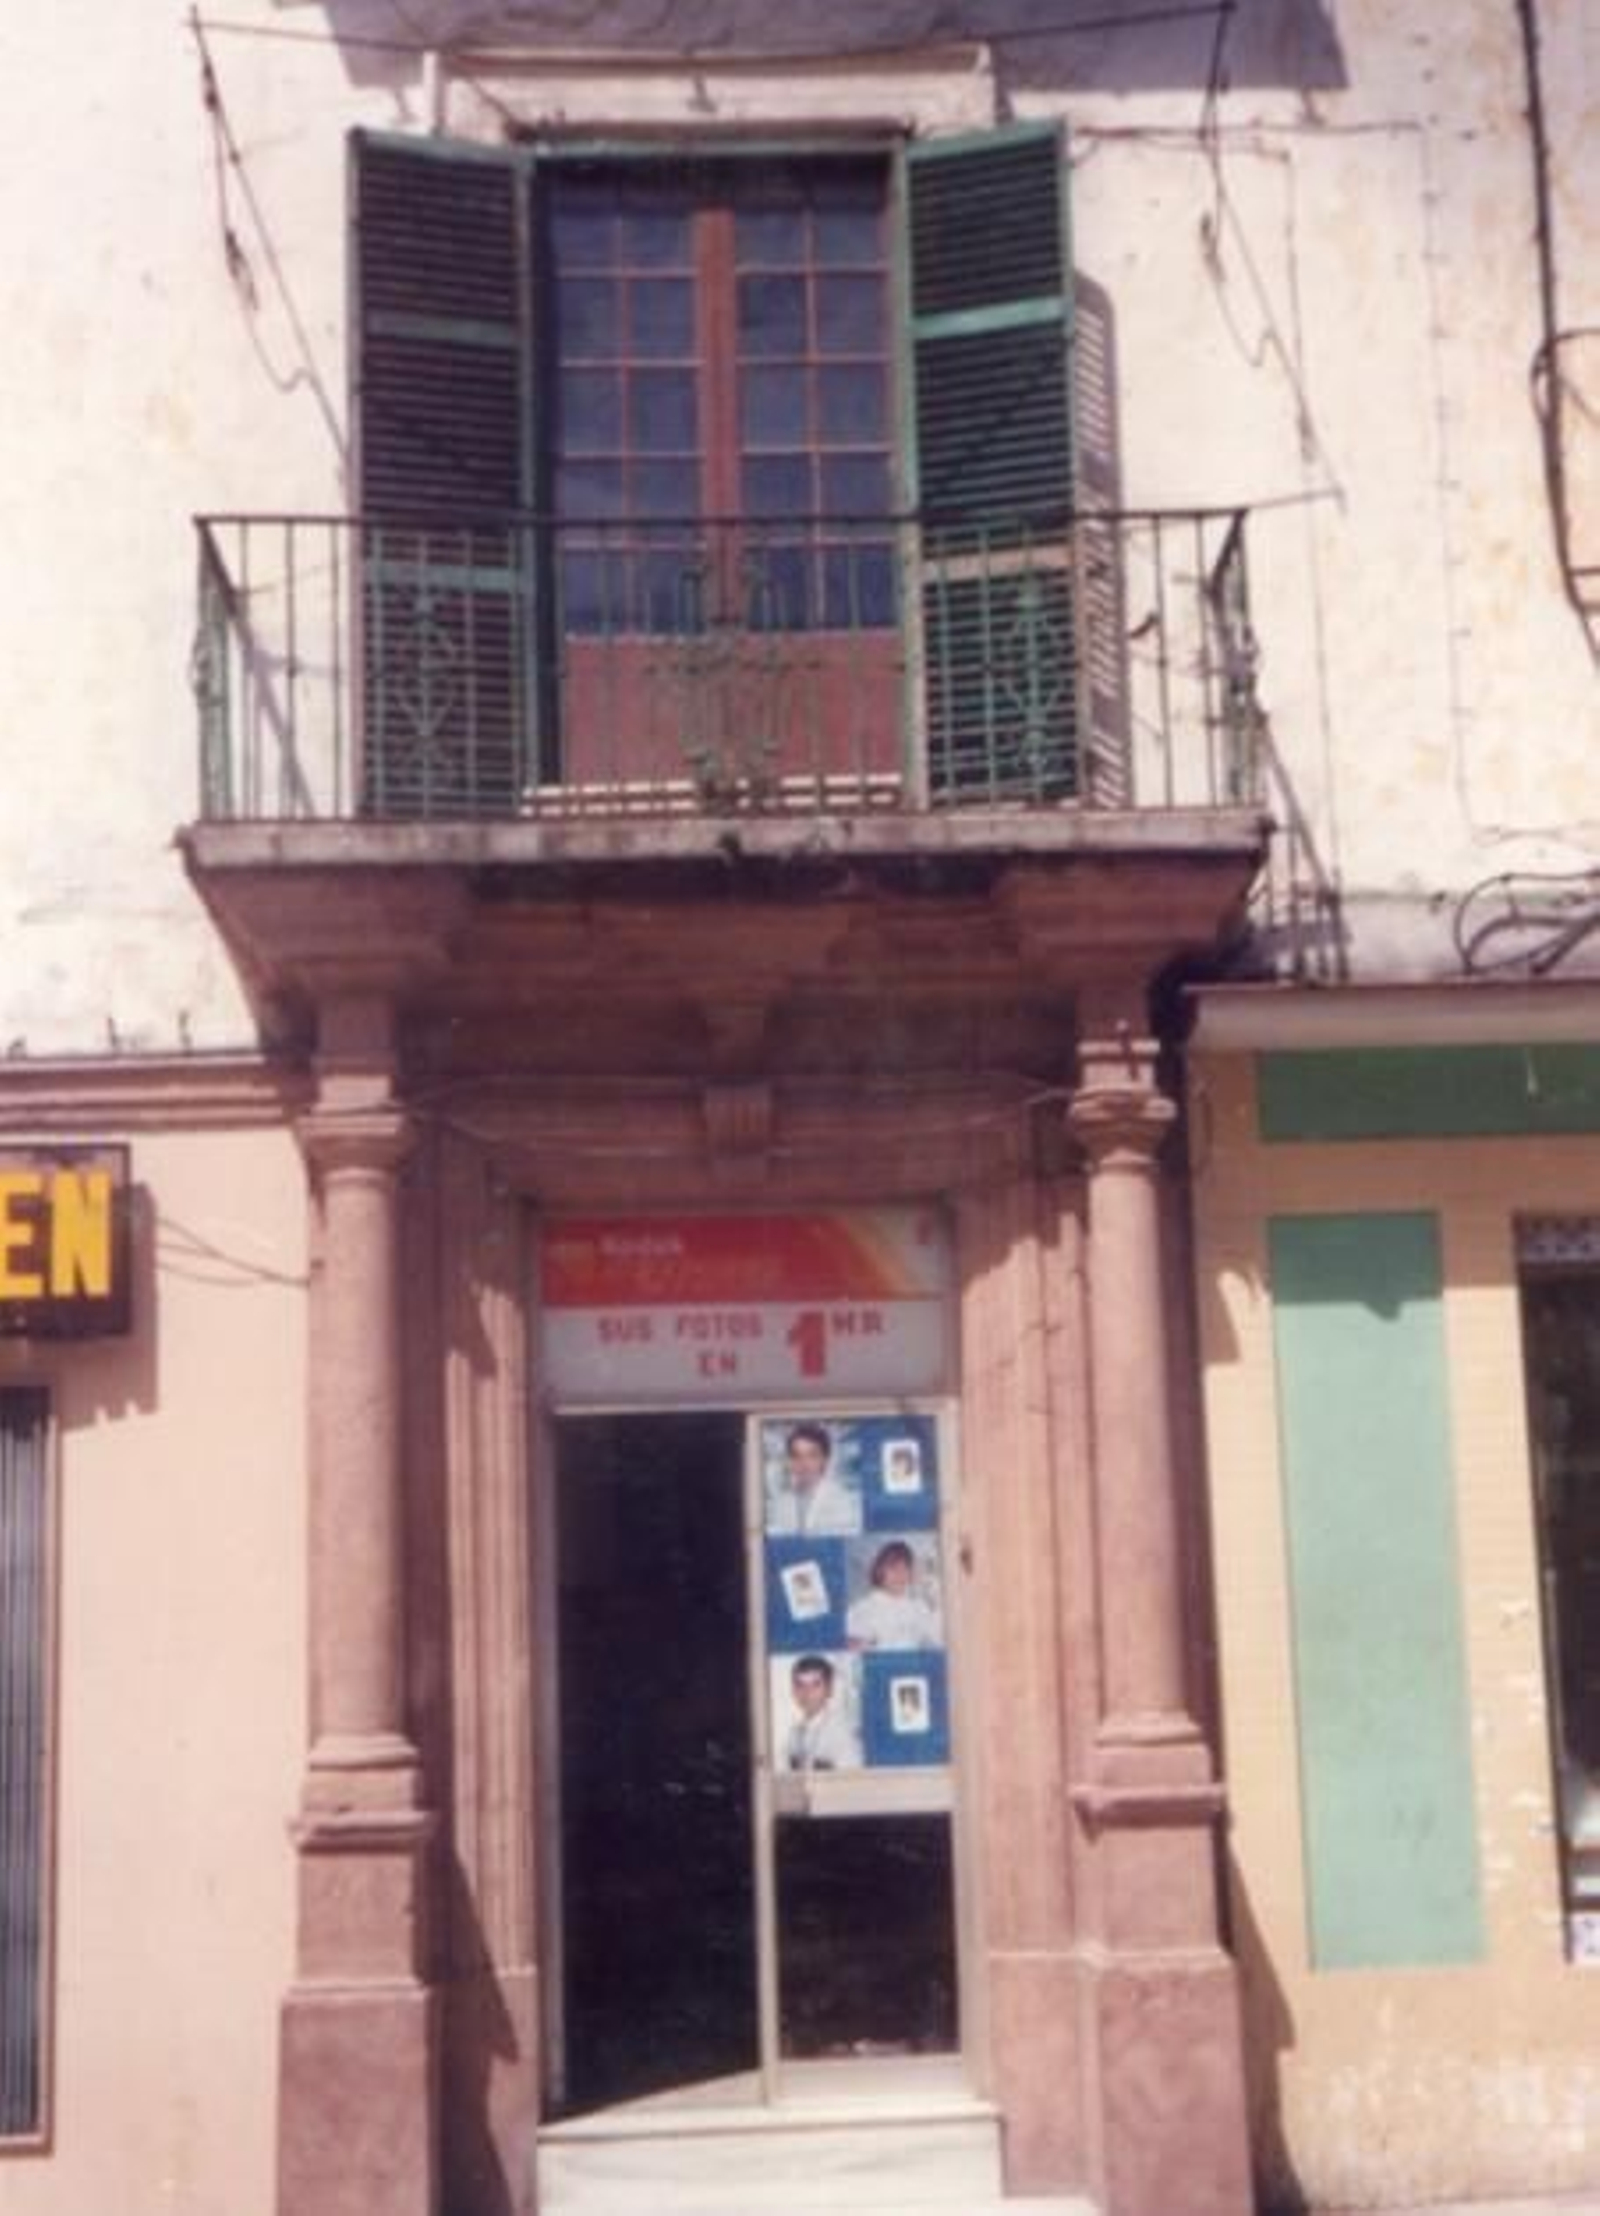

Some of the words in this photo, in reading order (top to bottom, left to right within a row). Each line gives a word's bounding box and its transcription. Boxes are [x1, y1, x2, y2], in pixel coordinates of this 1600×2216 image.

[0, 1172, 112, 1298] EN
[598, 1316, 652, 1344] SUS
[677, 1311, 763, 1341] FOTOS
[786, 1310, 827, 1381] 1
[697, 1350, 739, 1380] EN
